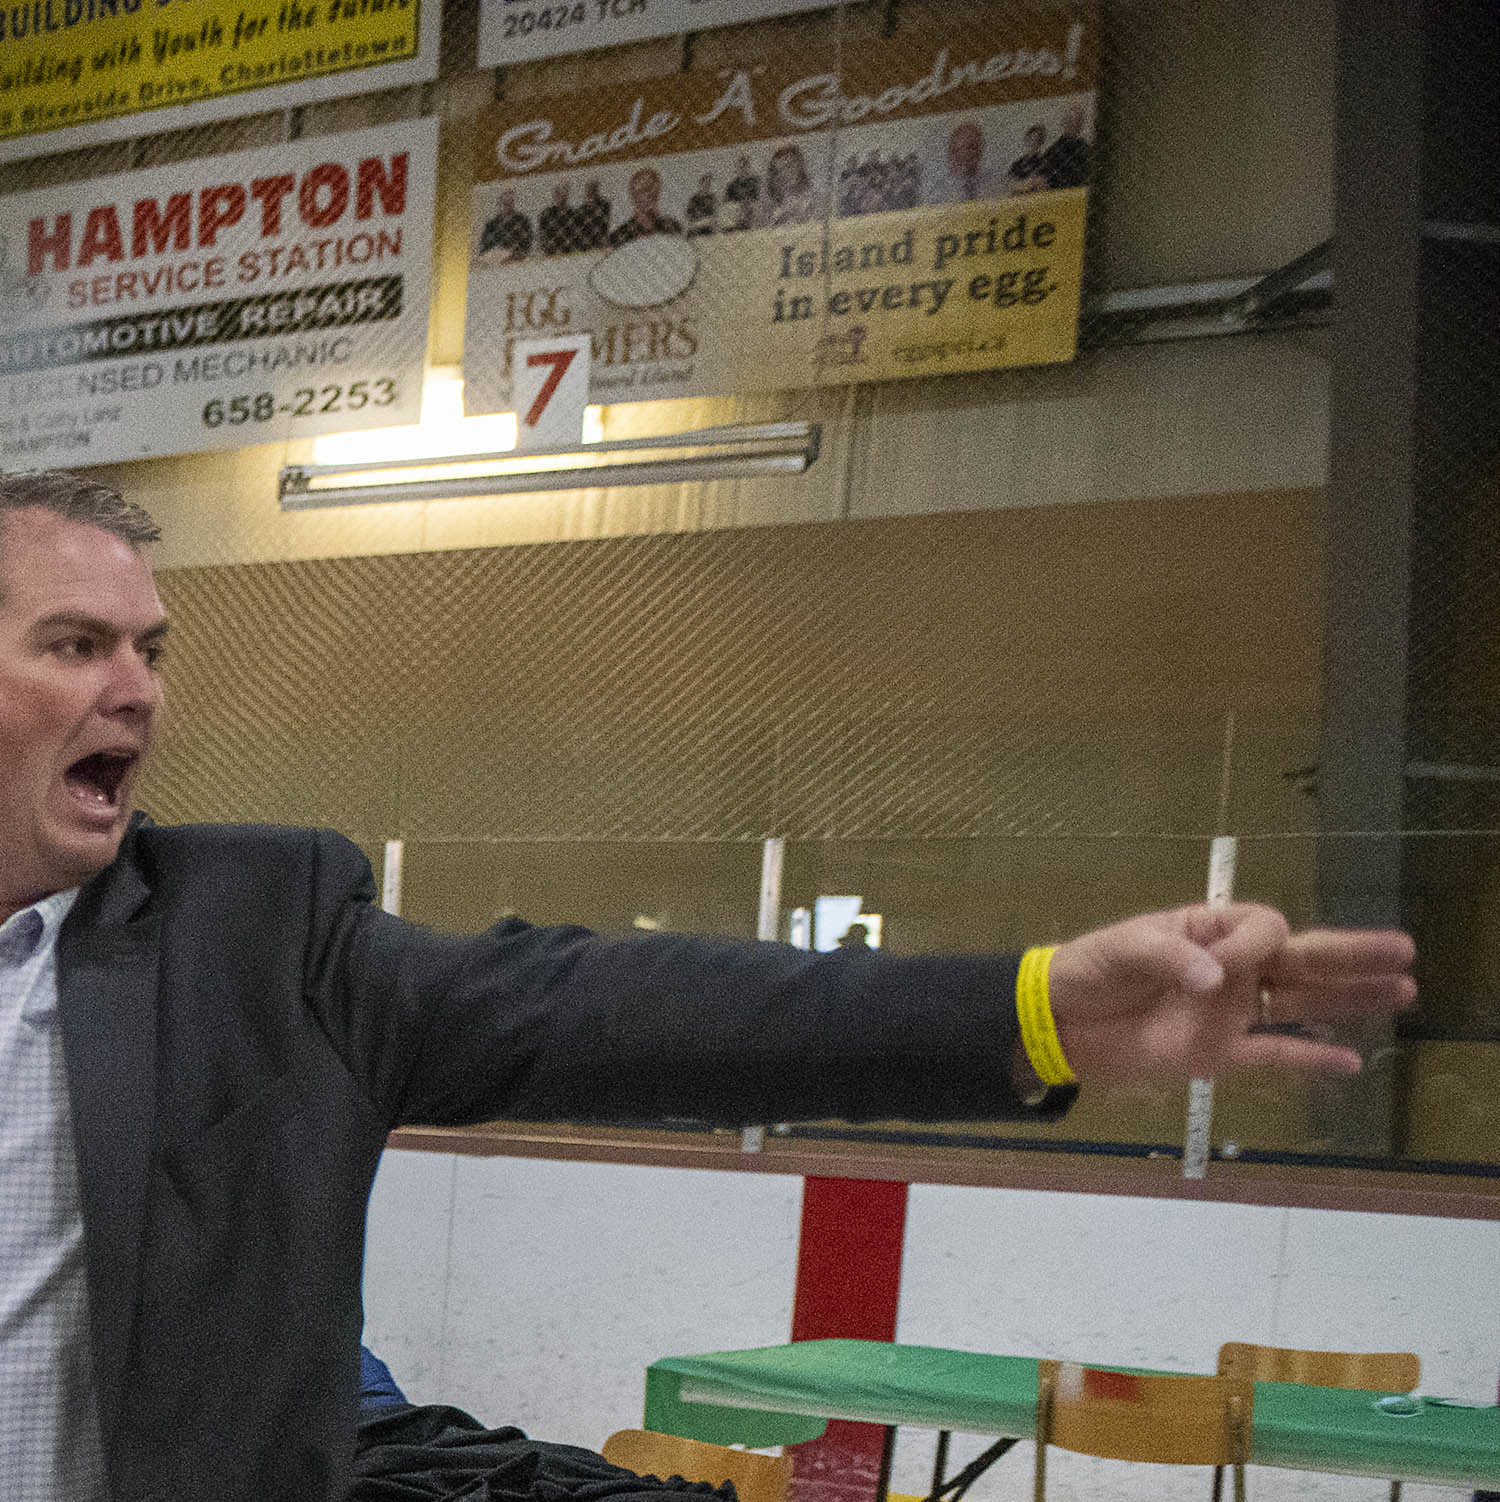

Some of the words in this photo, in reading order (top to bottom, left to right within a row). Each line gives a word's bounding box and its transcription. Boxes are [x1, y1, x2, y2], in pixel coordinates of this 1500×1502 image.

[93, 40, 142, 72] with
[152, 18, 223, 65] Youth
[232, 11, 267, 49] for
[278, 3, 316, 34] the
[219, 34, 408, 86] Charlottetown
[496, 99, 679, 173] Grade
[777, 22, 1083, 130] Goodness!
[27, 151, 410, 277] HAMPTON
[68, 258, 226, 310] SERVICE
[237, 229, 403, 284] STATION
[779, 229, 914, 279] Island
[933, 215, 1056, 272] pride
[240, 287, 387, 332] REPAIR
[773, 287, 813, 324] in
[828, 278, 954, 316] every
[967, 266, 1057, 309] egg.
[173, 336, 355, 385] MECHANIC
[501, 318, 698, 378] MERS
[203, 376, 398, 429] 658-2253
[525, 349, 579, 427] 7
